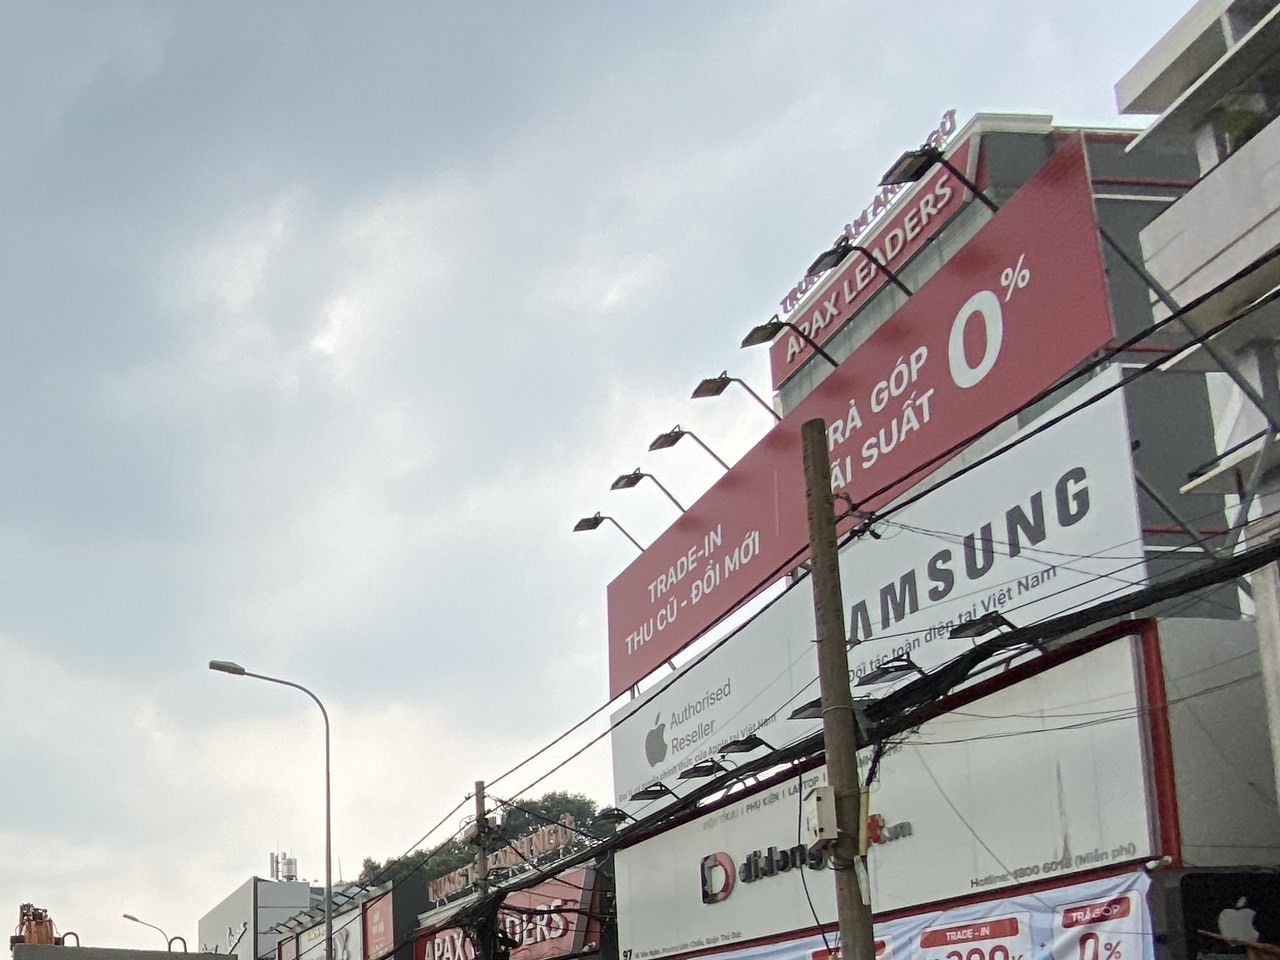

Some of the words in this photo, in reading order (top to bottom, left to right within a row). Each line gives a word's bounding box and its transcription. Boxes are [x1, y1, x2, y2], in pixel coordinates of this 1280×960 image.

[786, 290, 840, 363] APAX
[844, 174, 954, 303] LEADERS
[825, 398, 863, 452] RẢ
[871, 346, 929, 414] GÓP
[830, 456, 853, 494] ÃI
[861, 387, 935, 470] SUẤT
[625, 618, 654, 656] THU
[657, 595, 678, 632] CŨ
[691, 559, 720, 605] ĐỔI
[725, 530, 760, 580] MỚI
[648, 523, 723, 604] TRADE-IN
[850, 466, 1091, 642] AMSUNG
[981, 591, 1013, 613] Việt
[1017, 565, 1058, 597] Nam
[670, 678, 732, 730] Authorised
[671, 719, 716, 755] Reseller
[622, 949, 633, 960] 97
[945, 928, 974, 943] TRADE
